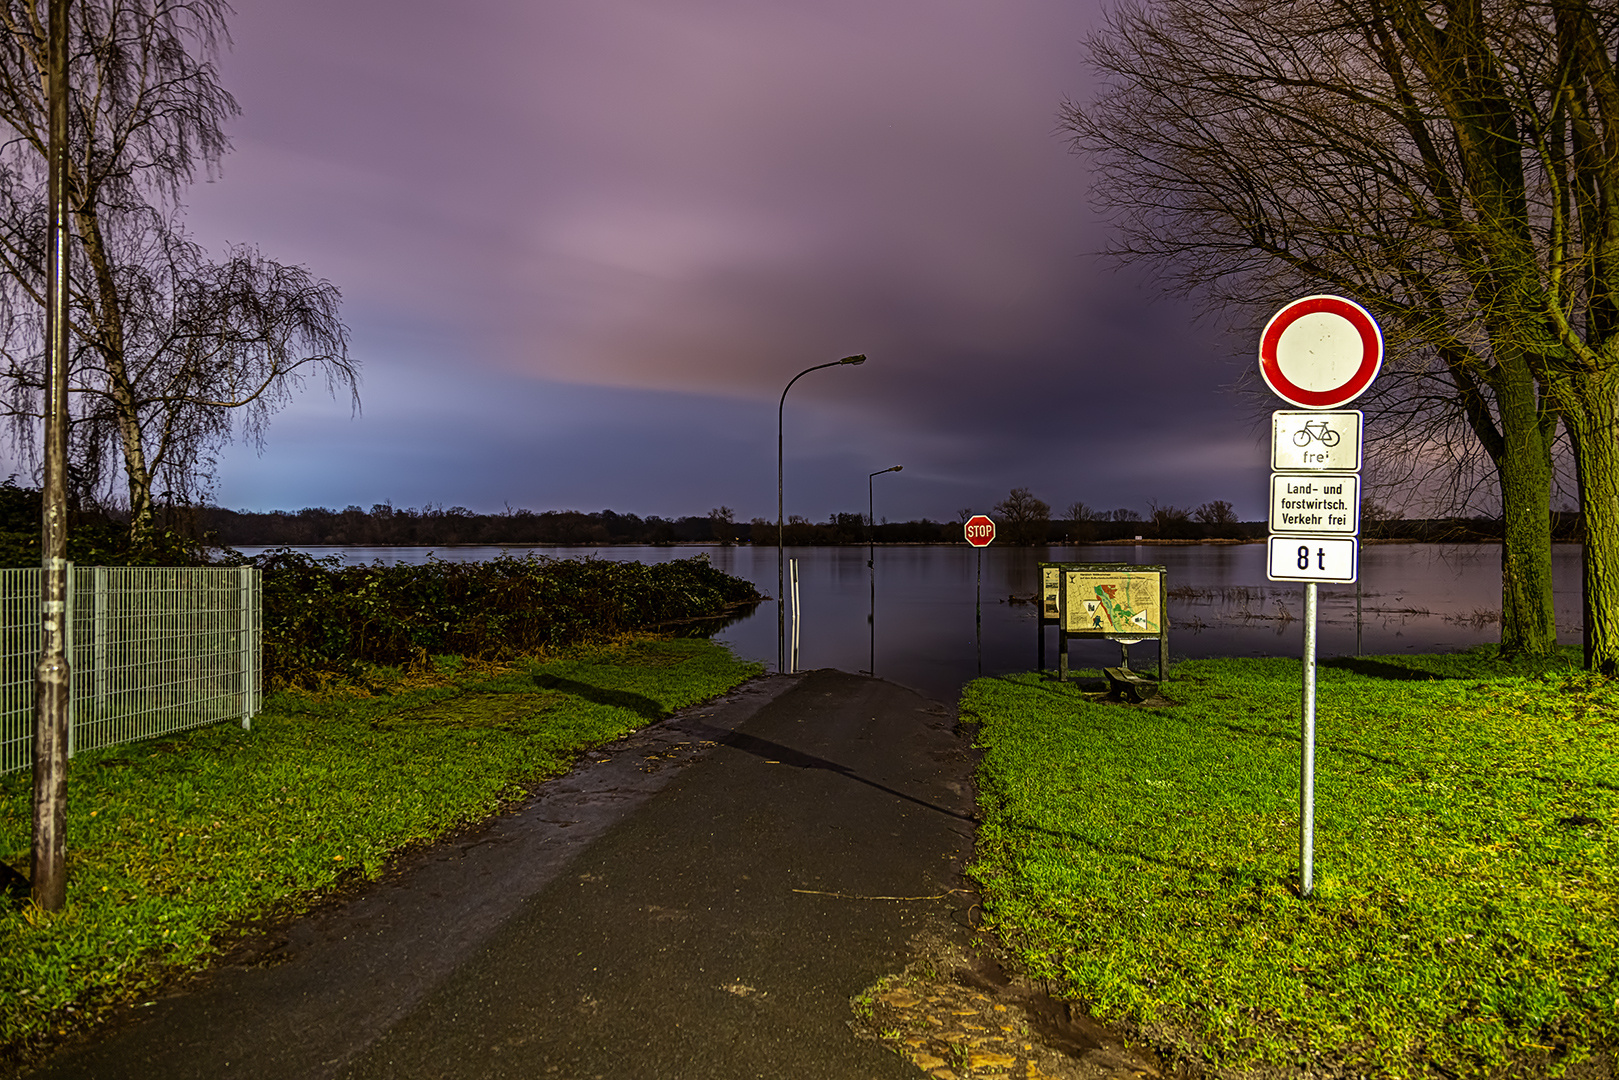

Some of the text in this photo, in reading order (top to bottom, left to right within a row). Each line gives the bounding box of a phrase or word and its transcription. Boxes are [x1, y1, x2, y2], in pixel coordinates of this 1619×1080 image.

[1287, 483, 1342, 494] Land- und
[1281, 498, 1348, 510] forstwirtsch.
[1282, 513, 1346, 525] Verkehr frei
[968, 525, 992, 537] STOP
[1297, 545, 1325, 570] 8 t
